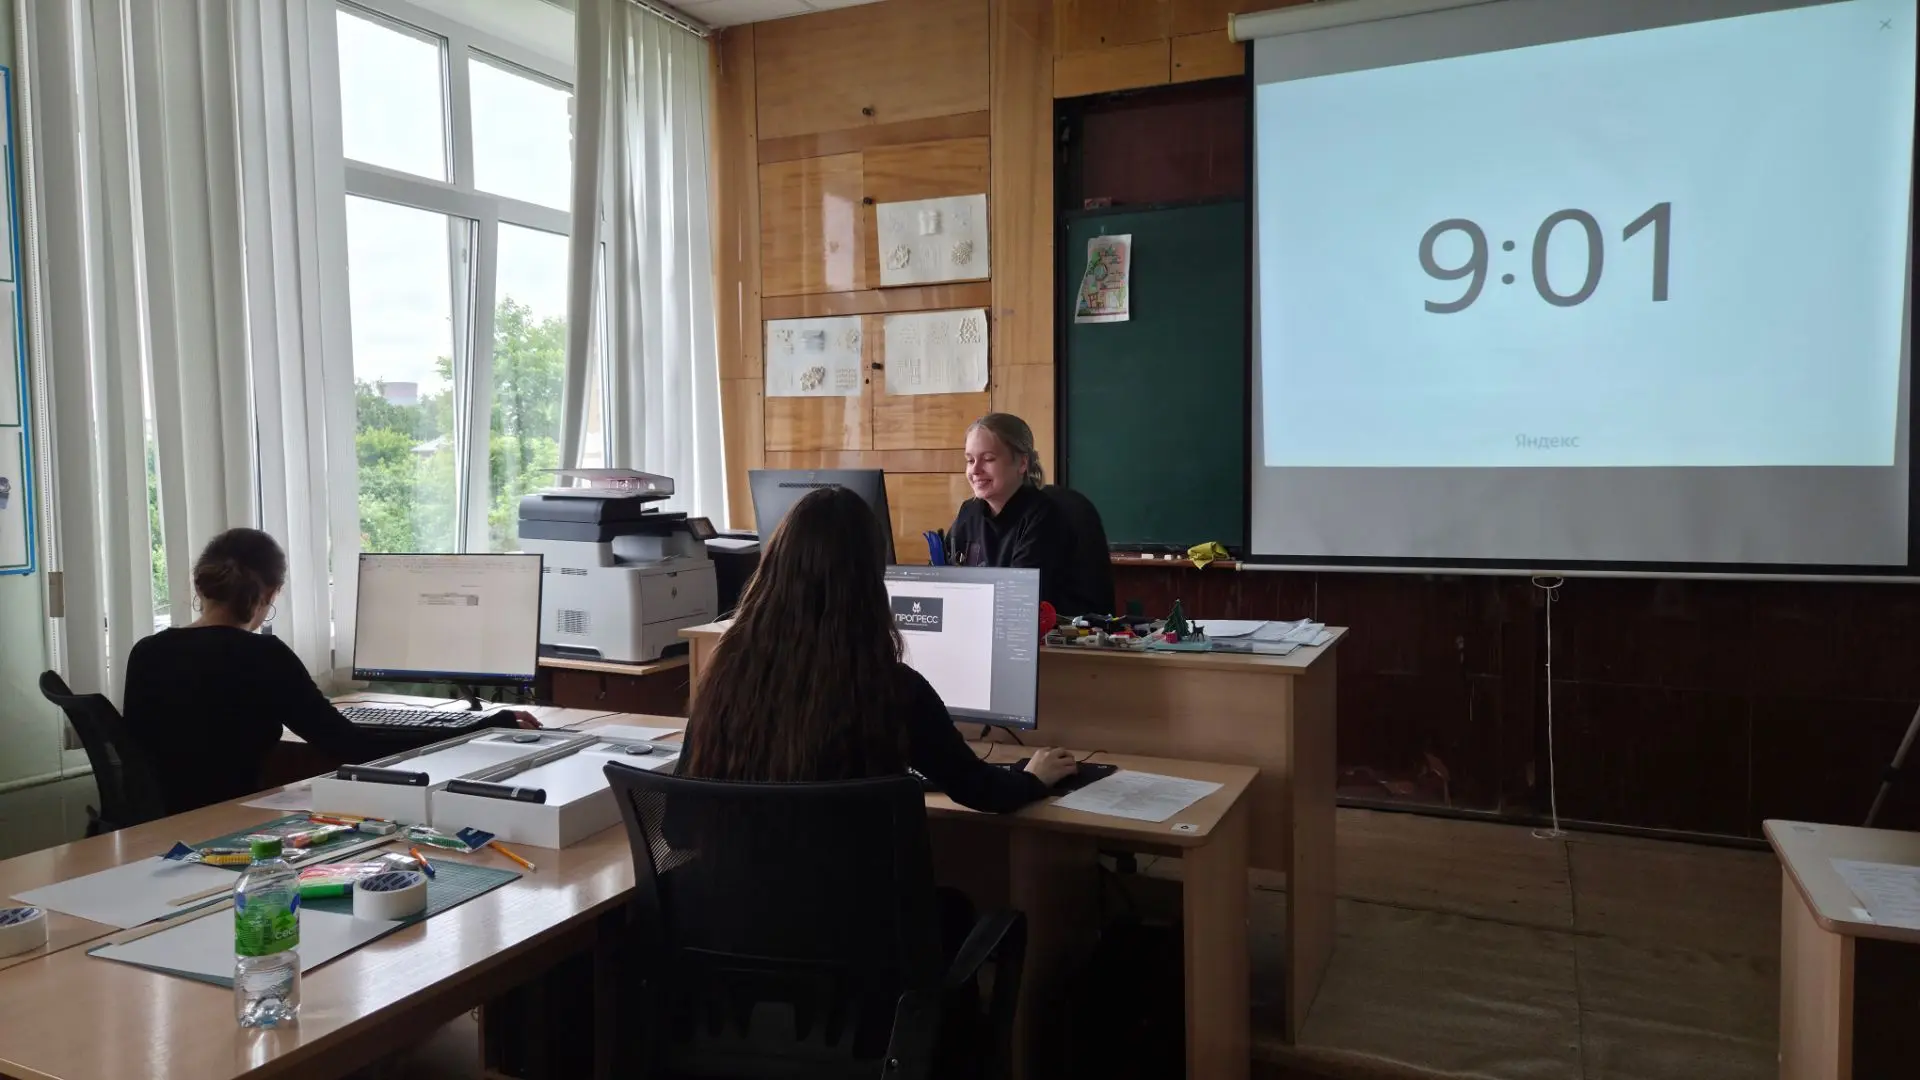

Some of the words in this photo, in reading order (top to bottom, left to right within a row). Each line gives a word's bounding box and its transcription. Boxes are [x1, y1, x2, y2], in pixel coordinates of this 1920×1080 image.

[1418, 201, 1672, 315] 9:01
[1514, 433, 1581, 450] Яндекс
[895, 613, 939, 624] ПРОГРЕСС
